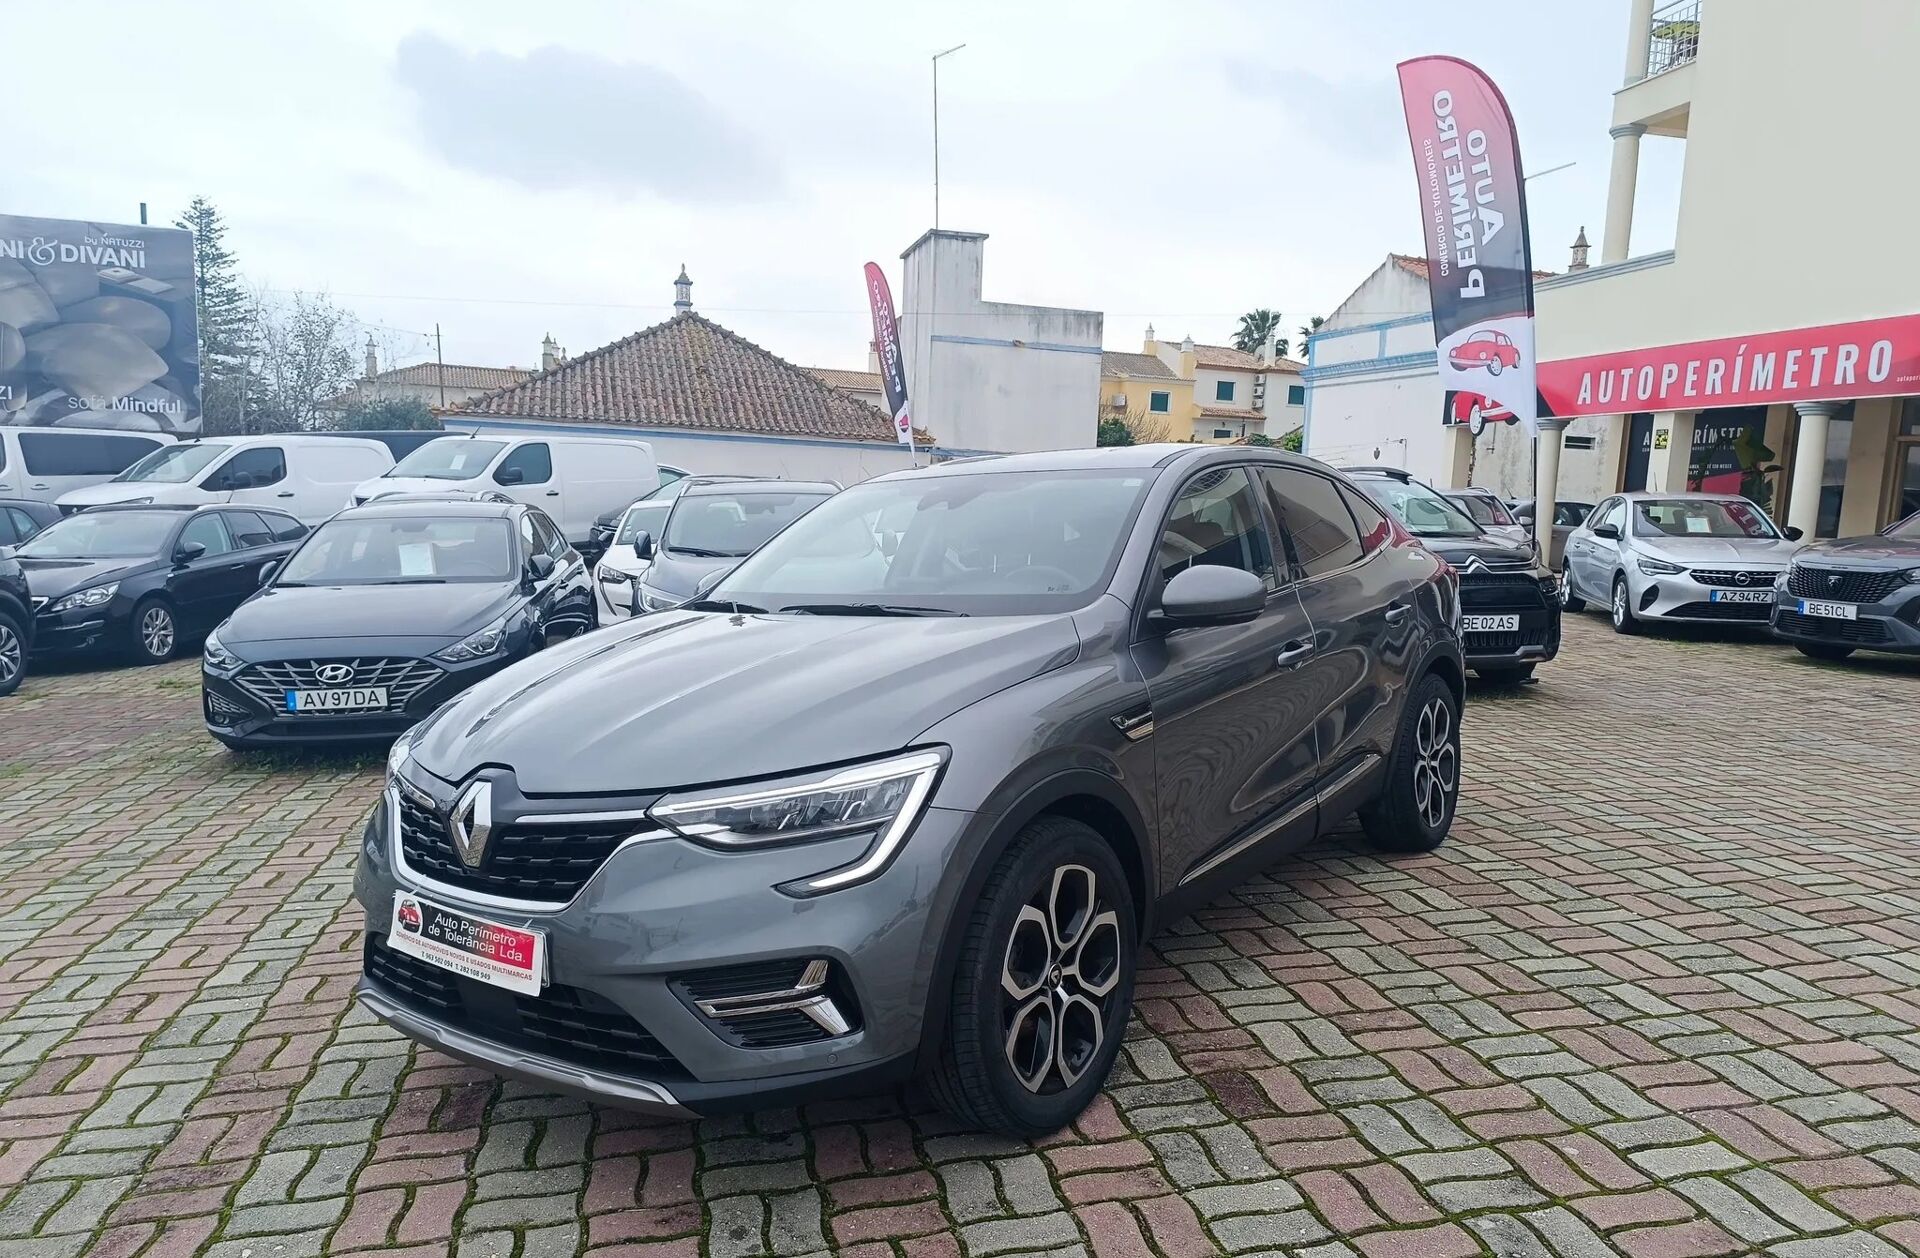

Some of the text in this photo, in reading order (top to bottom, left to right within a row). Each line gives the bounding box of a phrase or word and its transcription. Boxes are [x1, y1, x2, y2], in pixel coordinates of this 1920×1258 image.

[84, 236, 97, 246] by
[60, 243, 146, 268] DIVANI
[1577, 340, 1893, 405] AUTOPERÍMETRO
[67, 395, 181, 413] sofa Mindful
[434, 913, 516, 947] Auto Perímetro
[428, 923, 526, 963] de Tolerância Lda.
[460, 966, 469, 974] 282
[491, 964, 533, 981] MULTIMARCAS
